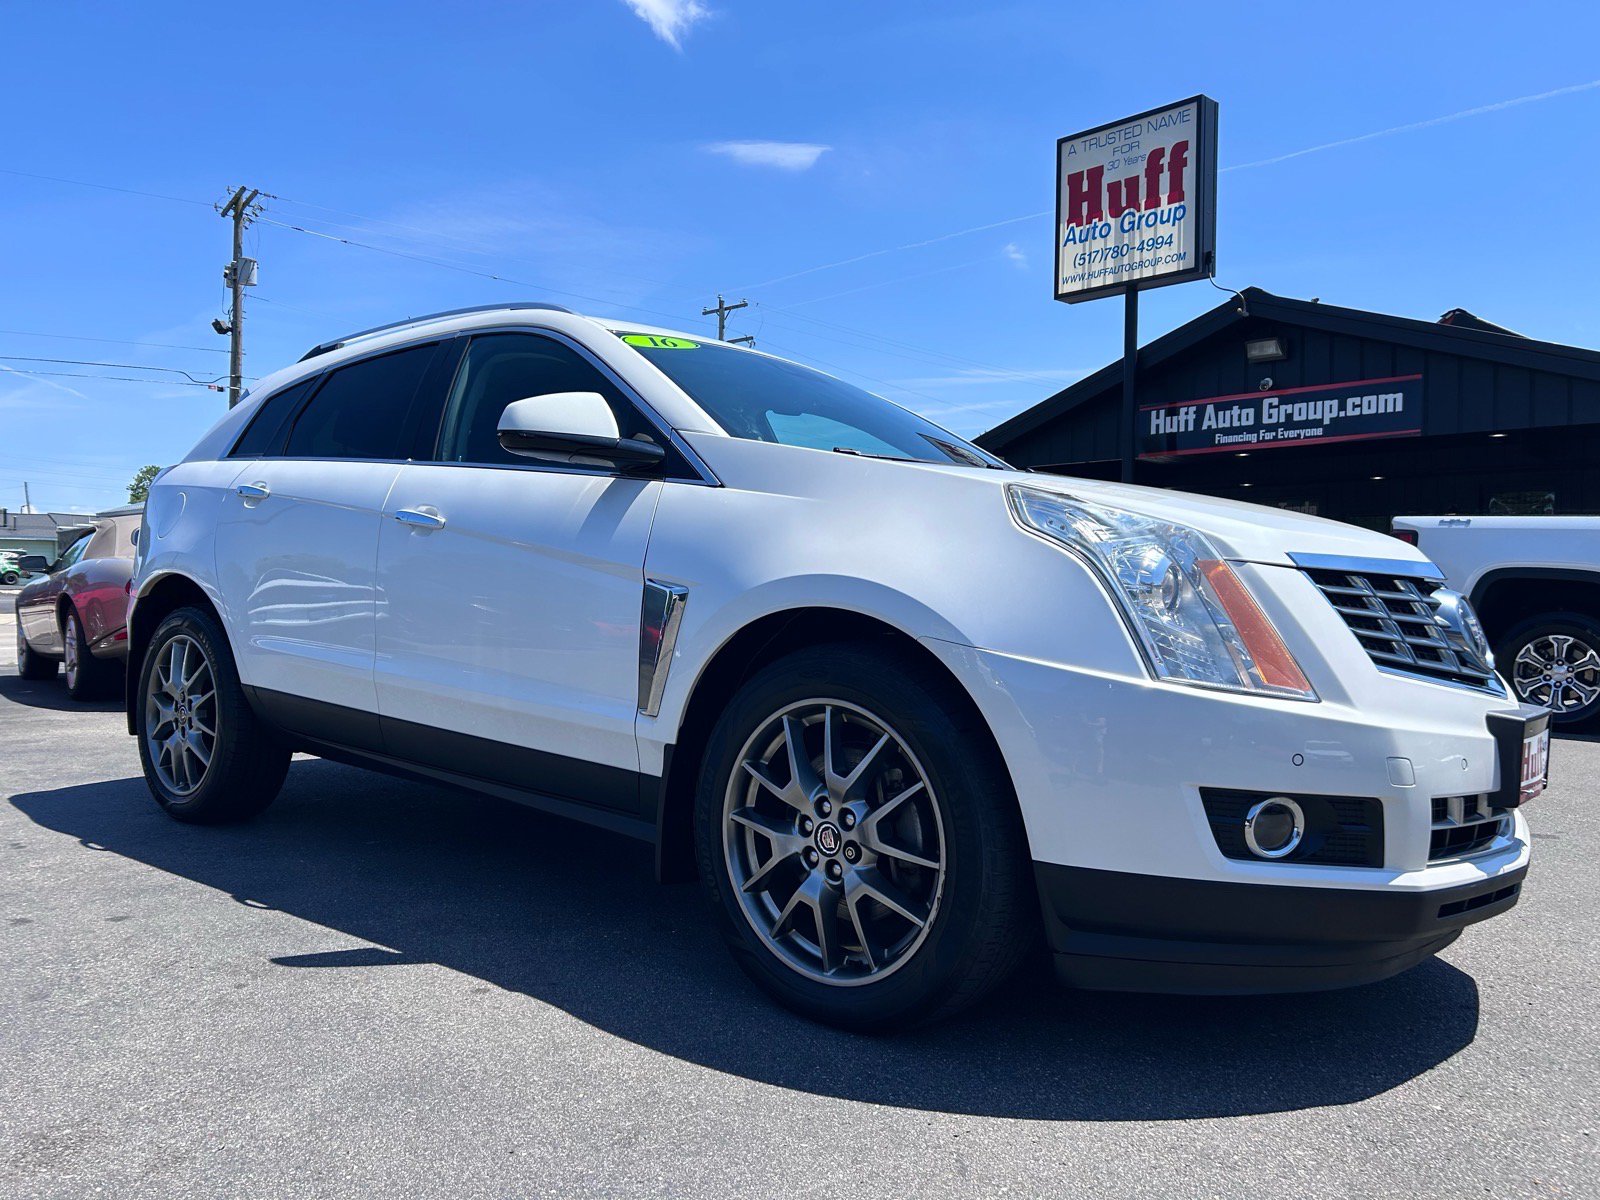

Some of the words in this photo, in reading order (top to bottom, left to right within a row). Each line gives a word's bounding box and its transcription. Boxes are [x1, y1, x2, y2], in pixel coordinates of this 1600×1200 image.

[1067, 144, 1077, 157] A
[1081, 124, 1142, 153] TRUSTED
[1147, 108, 1191, 134] NAME
[1112, 140, 1140, 156] FOR
[1107, 159, 1120, 171] 30
[1123, 153, 1147, 166] Years
[1066, 140, 1189, 229] Huff
[1063, 221, 1112, 247] Auto
[1120, 204, 1187, 234] Group
[1073, 233, 1174, 268] (517)780-4994
[1062, 251, 1187, 285] WWW.HUFFAUTOGROUP.COM
[647, 336, 678, 348] 16
[1150, 406, 1196, 435] Huff
[1202, 404, 1255, 430] Auto
[1262, 392, 1403, 425] Group.com
[1215, 431, 1257, 445] Financing
[1259, 429, 1276, 441] For
[1278, 426, 1323, 440] Everyone
